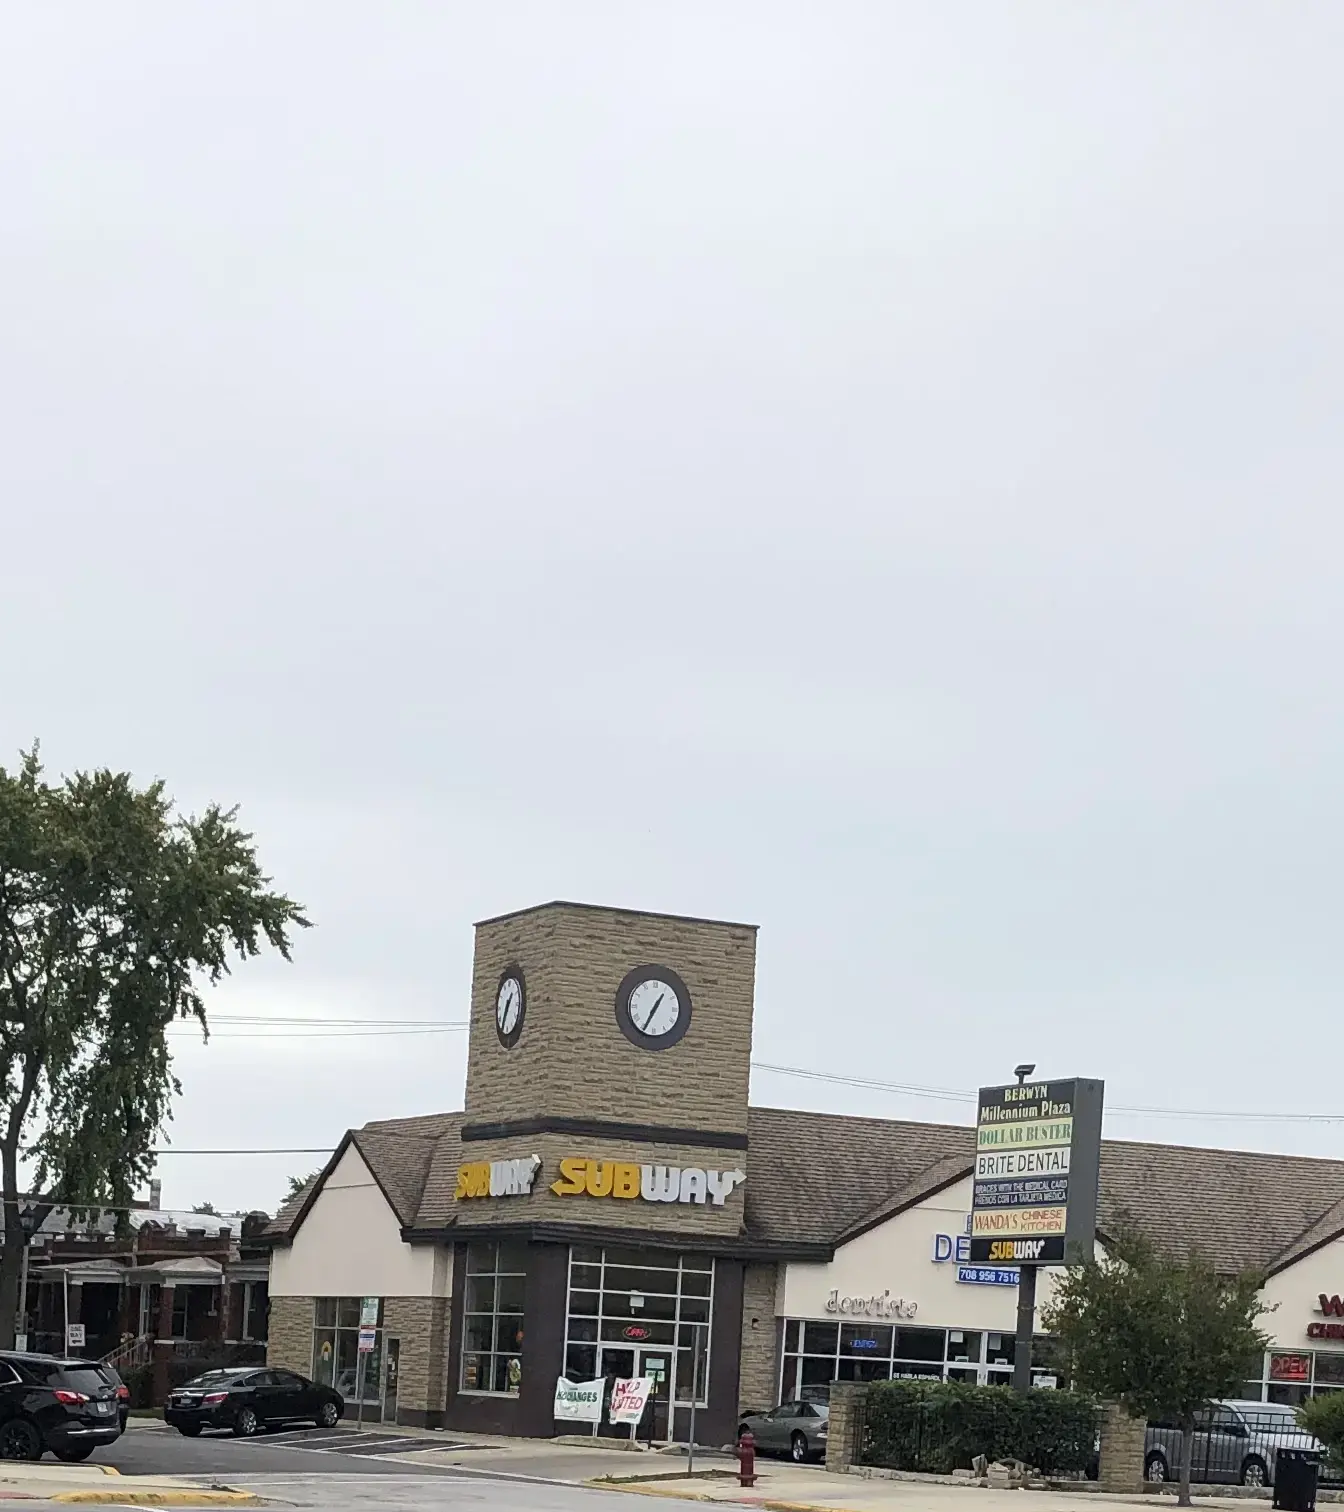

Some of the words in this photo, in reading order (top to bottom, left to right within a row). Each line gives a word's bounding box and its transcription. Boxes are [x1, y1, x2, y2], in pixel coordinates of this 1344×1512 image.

[1004, 1084, 1048, 1102] BERWYN
[980, 1103, 1038, 1122] Millennium
[1041, 1100, 1071, 1116] Plaza
[979, 1128, 1023, 1145] DOLLAR
[1026, 1123, 1071, 1141] BUSTER
[978, 1155, 1015, 1174] BRITE
[1017, 1151, 1068, 1172] DENTAL
[455, 1155, 541, 1200] SUBWAY
[550, 1158, 747, 1205] SUBWAY
[974, 1214, 1018, 1231] WANDA'S
[1021, 1209, 1063, 1221] CHINESE
[1020, 1221, 1062, 1231] KITCHEN
[988, 1239, 1046, 1260] SUBWAY
[960, 1269, 977, 1280] 708
[826, 1288, 918, 1318] dentista
